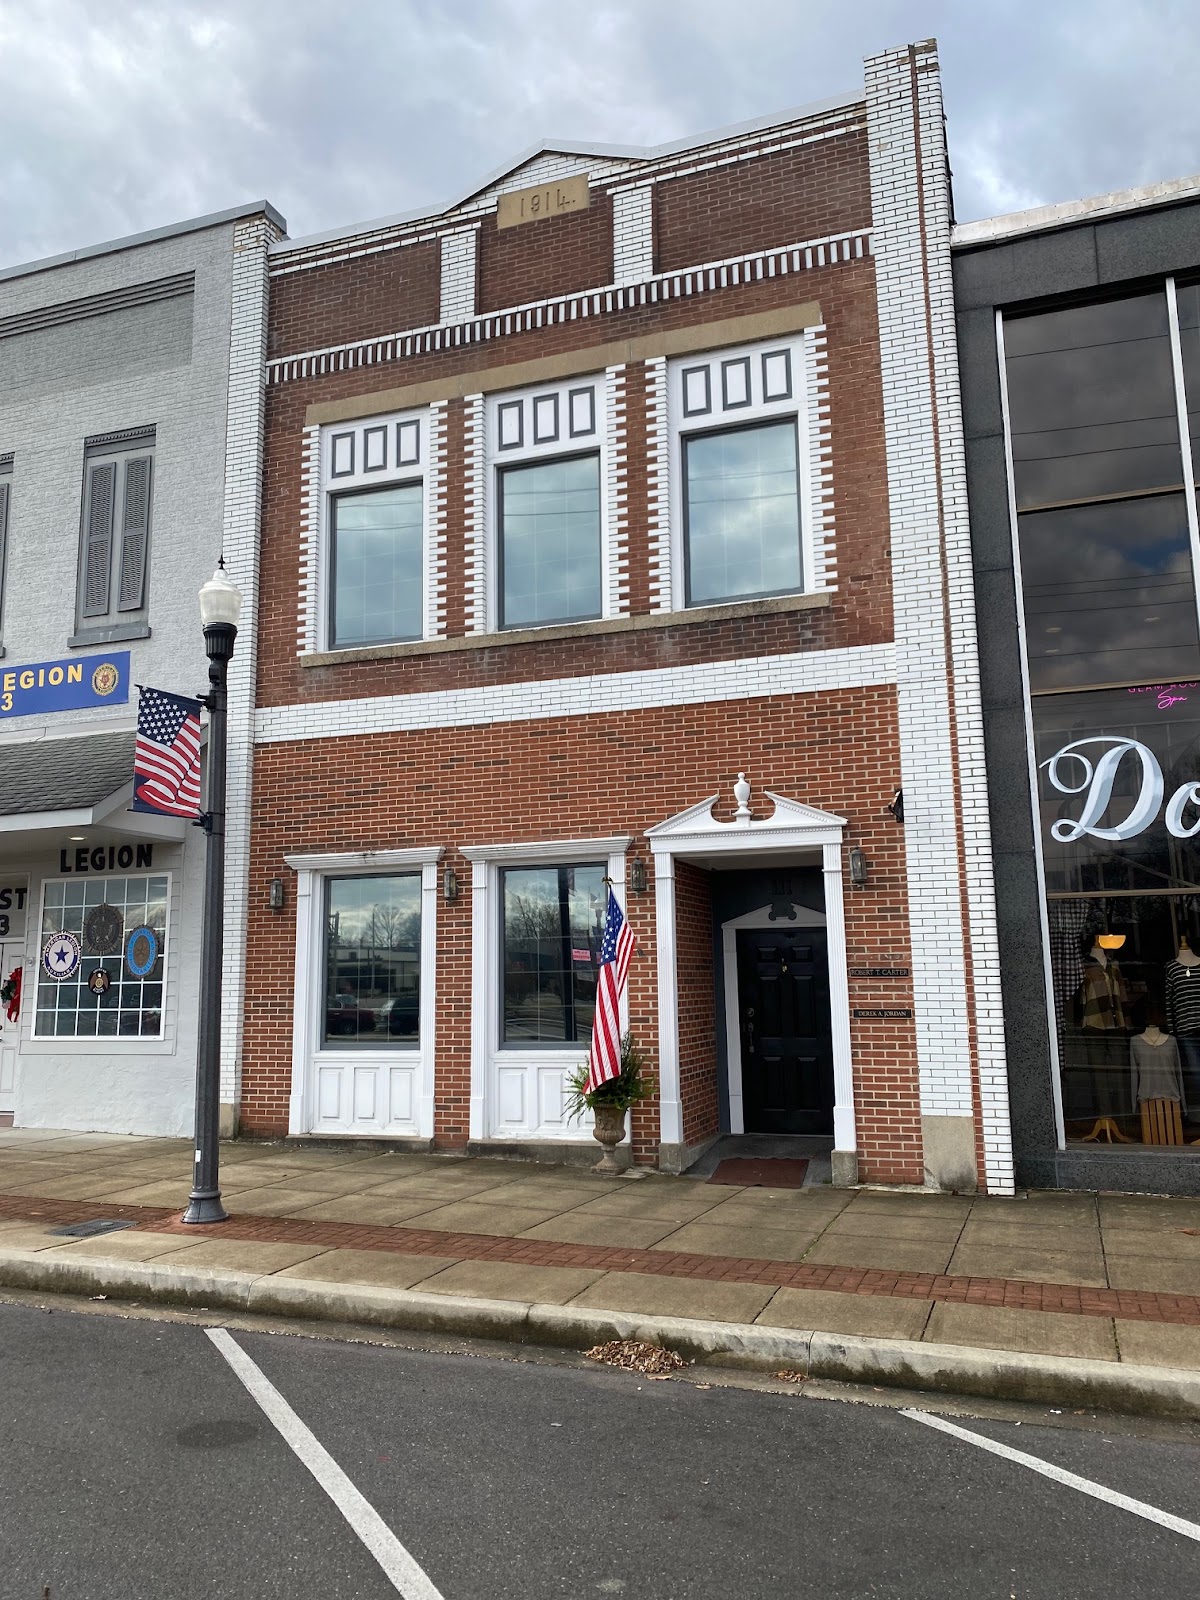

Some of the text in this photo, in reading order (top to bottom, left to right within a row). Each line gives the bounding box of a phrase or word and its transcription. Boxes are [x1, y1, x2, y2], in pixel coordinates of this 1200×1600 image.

[1, 692, 13, 711] 3
[60, 843, 153, 873] LEGION
[45, 935, 66, 958] AMERICAN
[66, 935, 79, 956] LEGION
[884, 1010, 907, 1018] JORDAN
